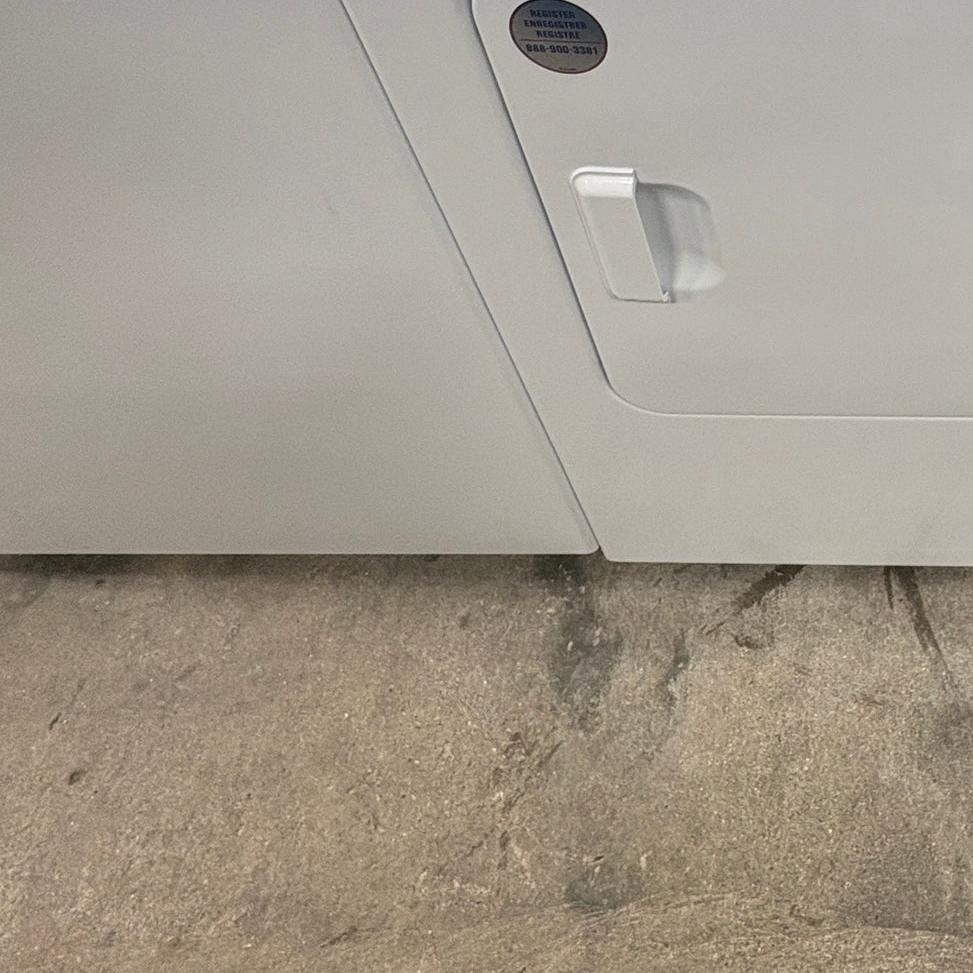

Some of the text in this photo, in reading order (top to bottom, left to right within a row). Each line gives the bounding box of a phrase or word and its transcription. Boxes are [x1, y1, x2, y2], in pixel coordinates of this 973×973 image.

[530, 10, 576, 19] REGISTER
[524, 20, 587, 29] ENREGISTRER
[536, 30, 581, 39] REGISTRE
[525, 44, 599, 55] 888-900-3381
